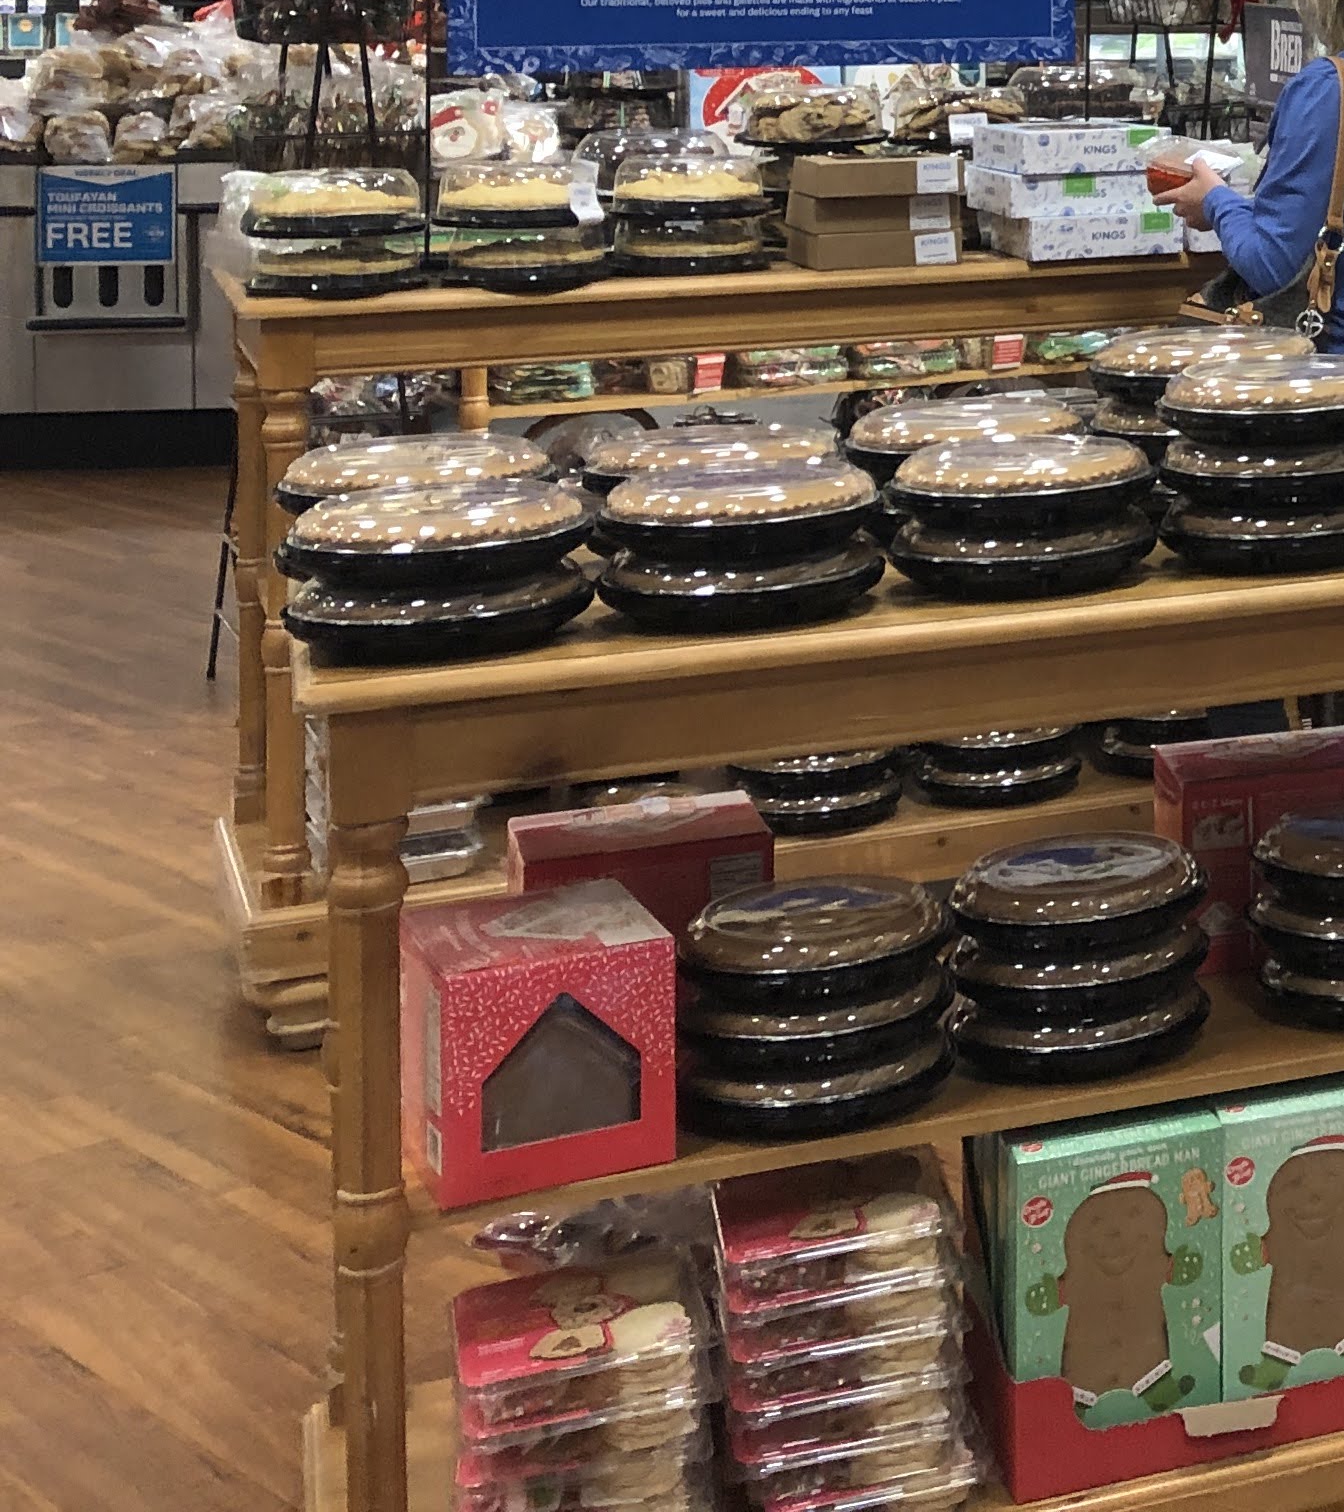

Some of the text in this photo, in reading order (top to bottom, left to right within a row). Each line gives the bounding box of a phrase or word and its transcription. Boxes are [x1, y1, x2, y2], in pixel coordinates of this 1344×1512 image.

[1083, 144, 1118, 155] KINGS
[46, 222, 133, 248] FREE
[1091, 231, 1126, 241] KINGS
[1241, 1136, 1277, 1149] GIANT
[1038, 1146, 1201, 1189] GIANT GINGERBREAD MAN
